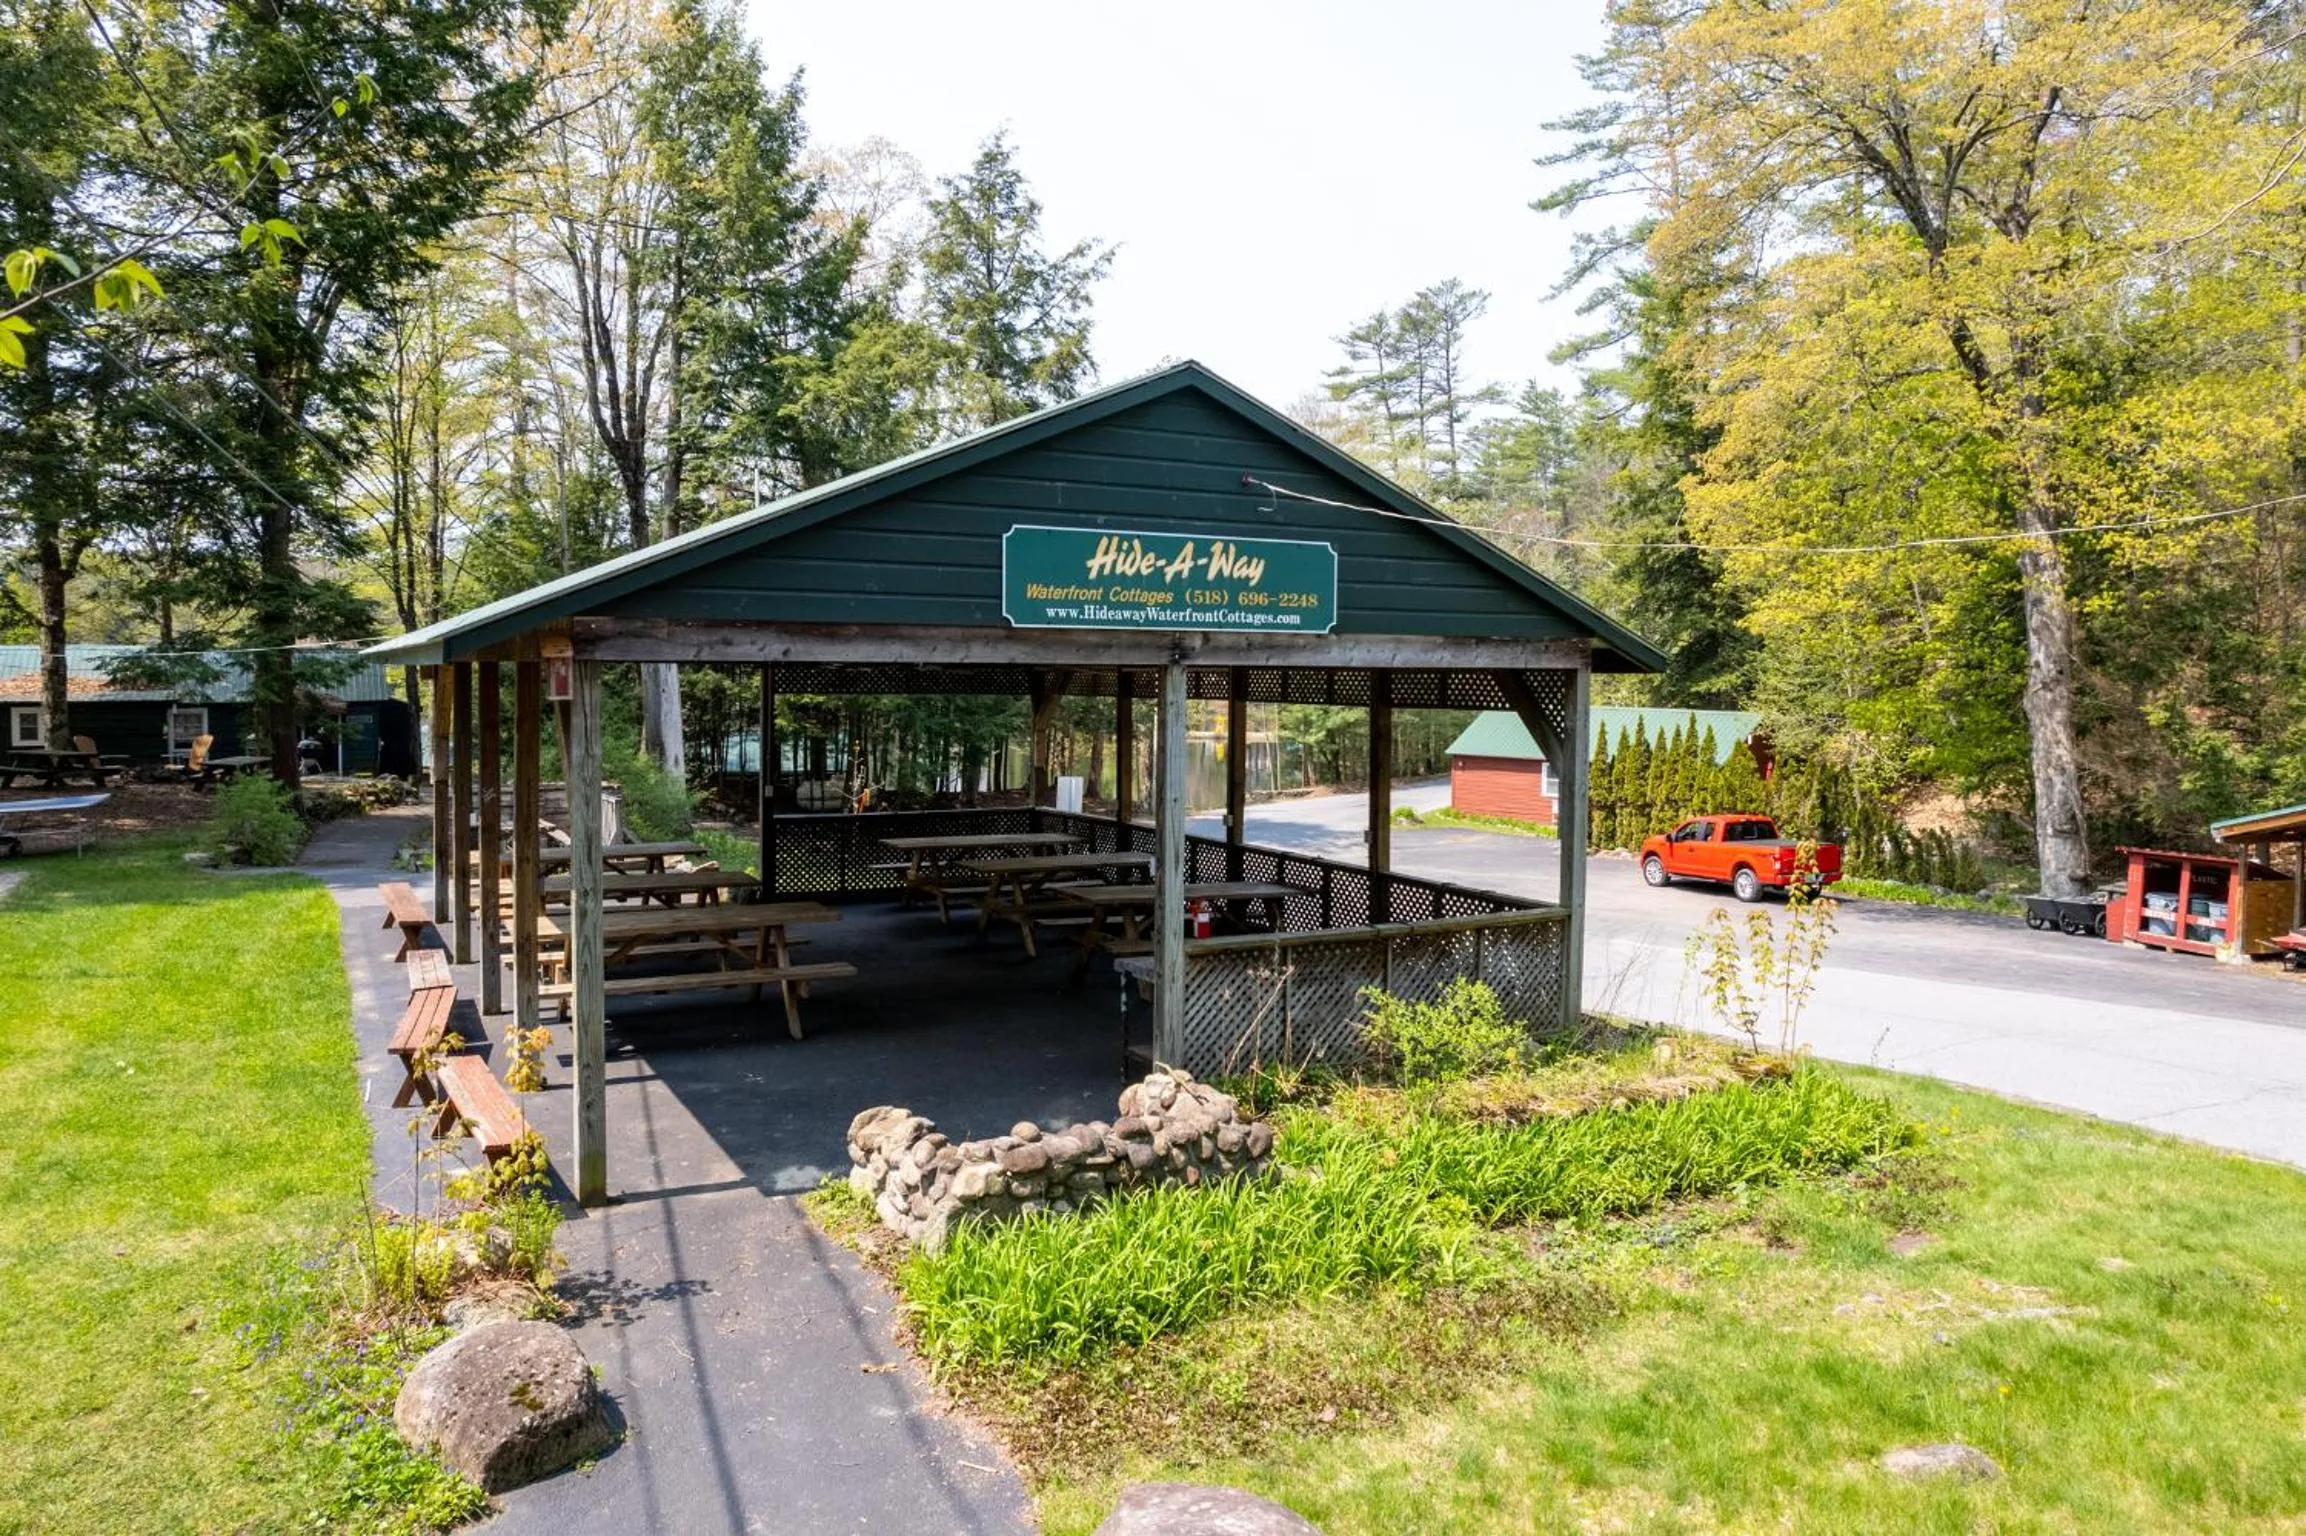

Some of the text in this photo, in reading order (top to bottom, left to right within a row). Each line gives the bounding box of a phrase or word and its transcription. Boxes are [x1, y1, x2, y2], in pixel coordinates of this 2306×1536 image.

[1086, 536, 1265, 586] Hide-A-Way
[1026, 583, 1319, 608] Waterfront Cottages (518) 696-2248
[1046, 604, 1301, 625] www.HideawayWaterfrontCottages.com
